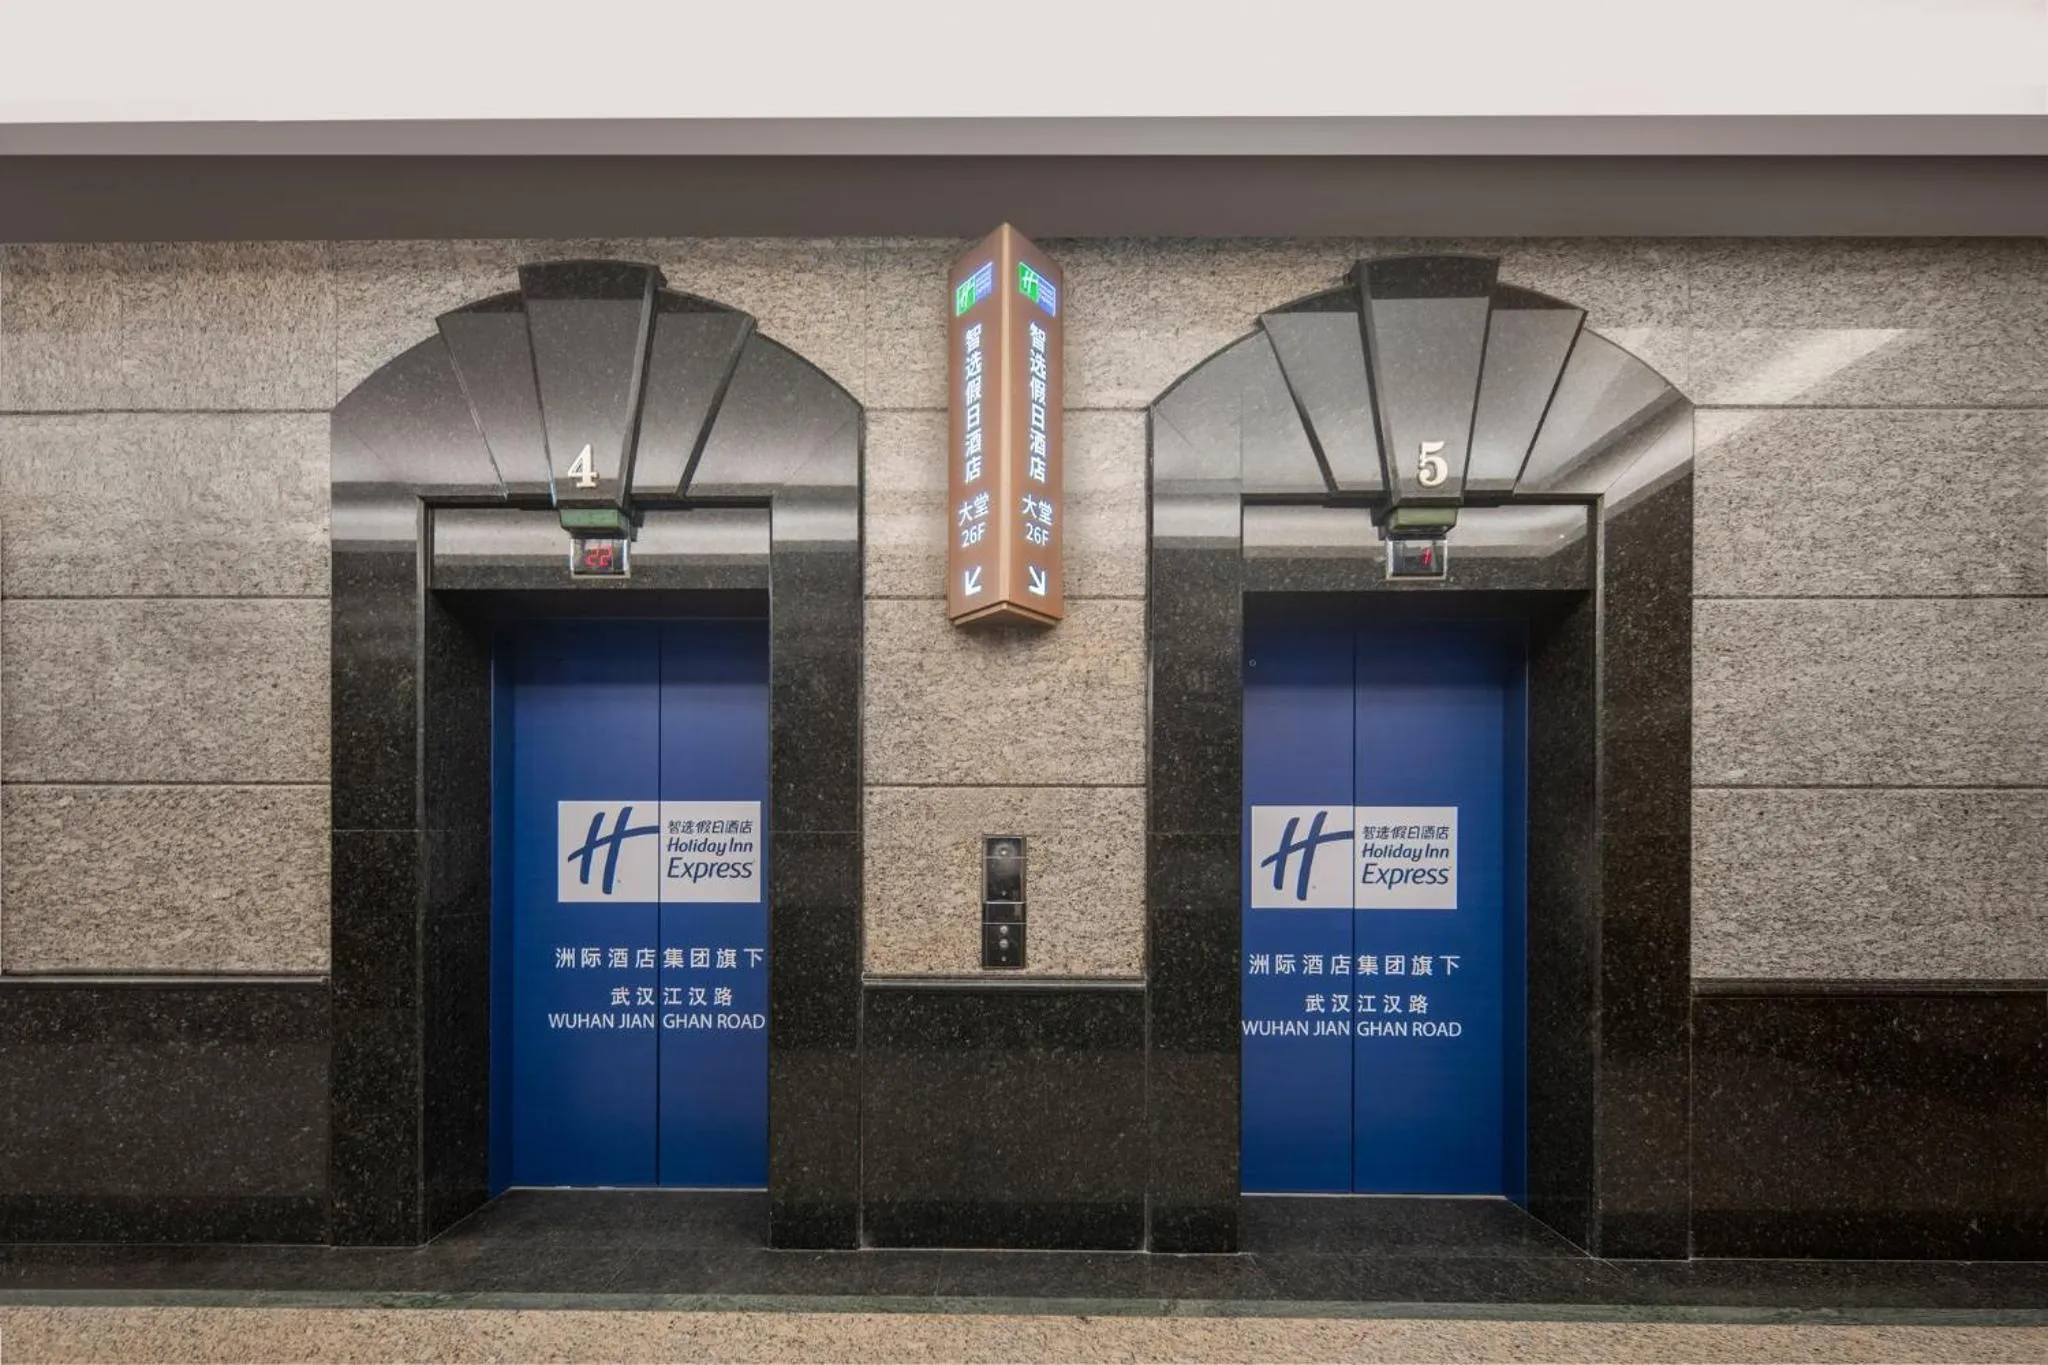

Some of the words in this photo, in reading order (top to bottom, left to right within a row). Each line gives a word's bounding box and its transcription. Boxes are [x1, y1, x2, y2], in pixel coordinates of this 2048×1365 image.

[965, 323, 983, 484] 智选假日酒店
[1030, 322, 1047, 484] 智选假日酒店
[568, 444, 598, 488] 4
[1418, 441, 1448, 487] 5
[959, 492, 989, 527] 大堂
[1022, 493, 1052, 526] 大堂
[961, 522, 986, 548] 26F
[1025, 522, 1049, 547] 26F
[667, 820, 753, 834] 智选假日酒店
[1363, 826, 1450, 840] 智选假日酒店
[667, 837, 727, 856] Holiday
[729, 837, 753, 853] Inn
[1362, 843, 1422, 862] Holiday
[1424, 844, 1450, 859] Inn
[667, 857, 753, 883] Express
[1361, 863, 1449, 890] Express
[555, 947, 764, 969] 洲际酒店集团旗下
[1249, 953, 1461, 975] 洲际酒店集团旗下
[611, 987, 733, 1006] 武汉江汉路
[1305, 994, 1429, 1014] 武汉江汉路
[548, 1013, 614, 1029] WUHAN
[618, 1013, 655, 1029] JIAN
[663, 1013, 713, 1029] GHAN
[717, 1013, 766, 1029] ROAD
[1241, 1020, 1309, 1036] WUHAN
[1313, 1020, 1350, 1037] JIAN
[1357, 1021, 1408, 1037] GHAN
[1412, 1021, 1462, 1037] ROAD
